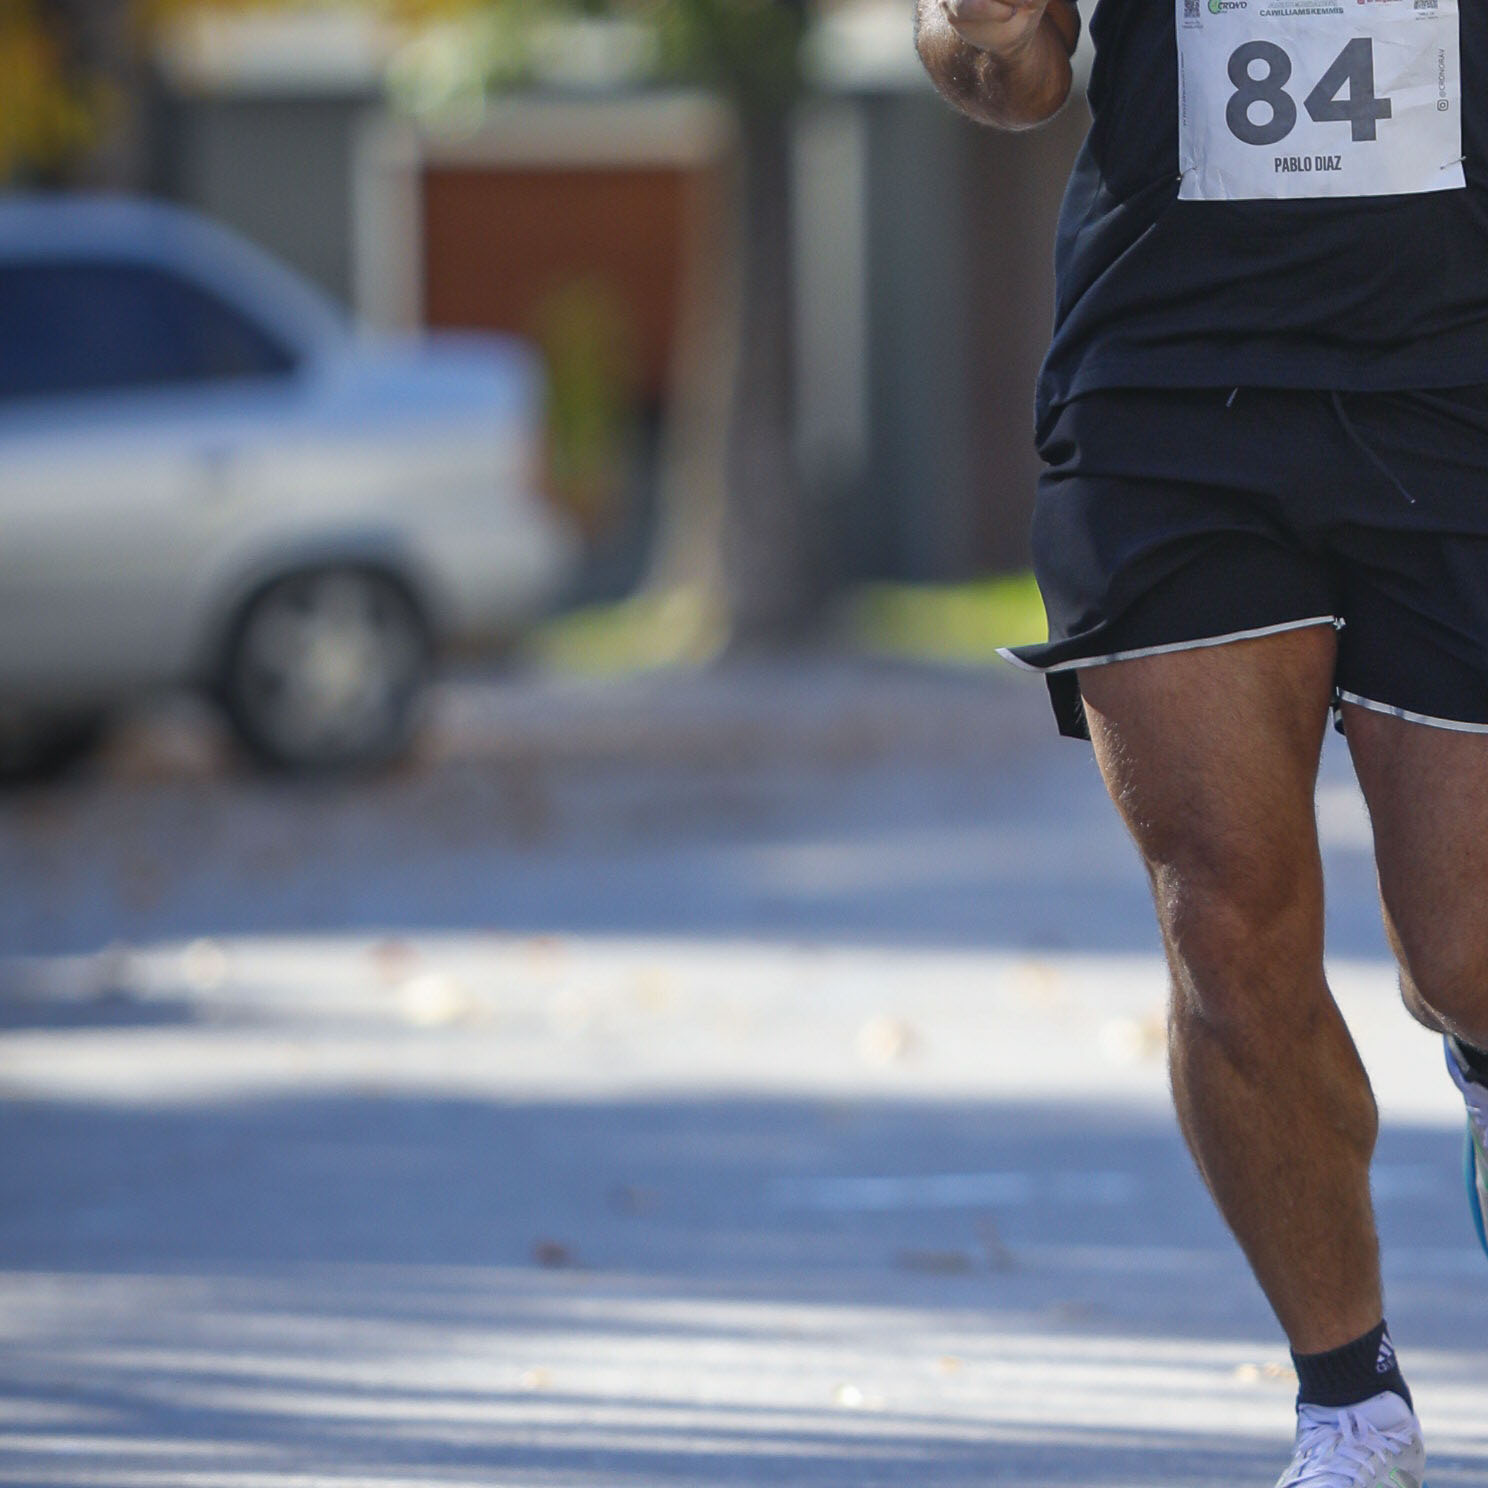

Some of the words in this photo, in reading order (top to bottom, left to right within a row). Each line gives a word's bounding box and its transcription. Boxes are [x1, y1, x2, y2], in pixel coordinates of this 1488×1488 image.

[1226, 37, 1392, 146] 84
[1274, 157, 1312, 173] PABLO
[1315, 155, 1342, 171] DIAZ
